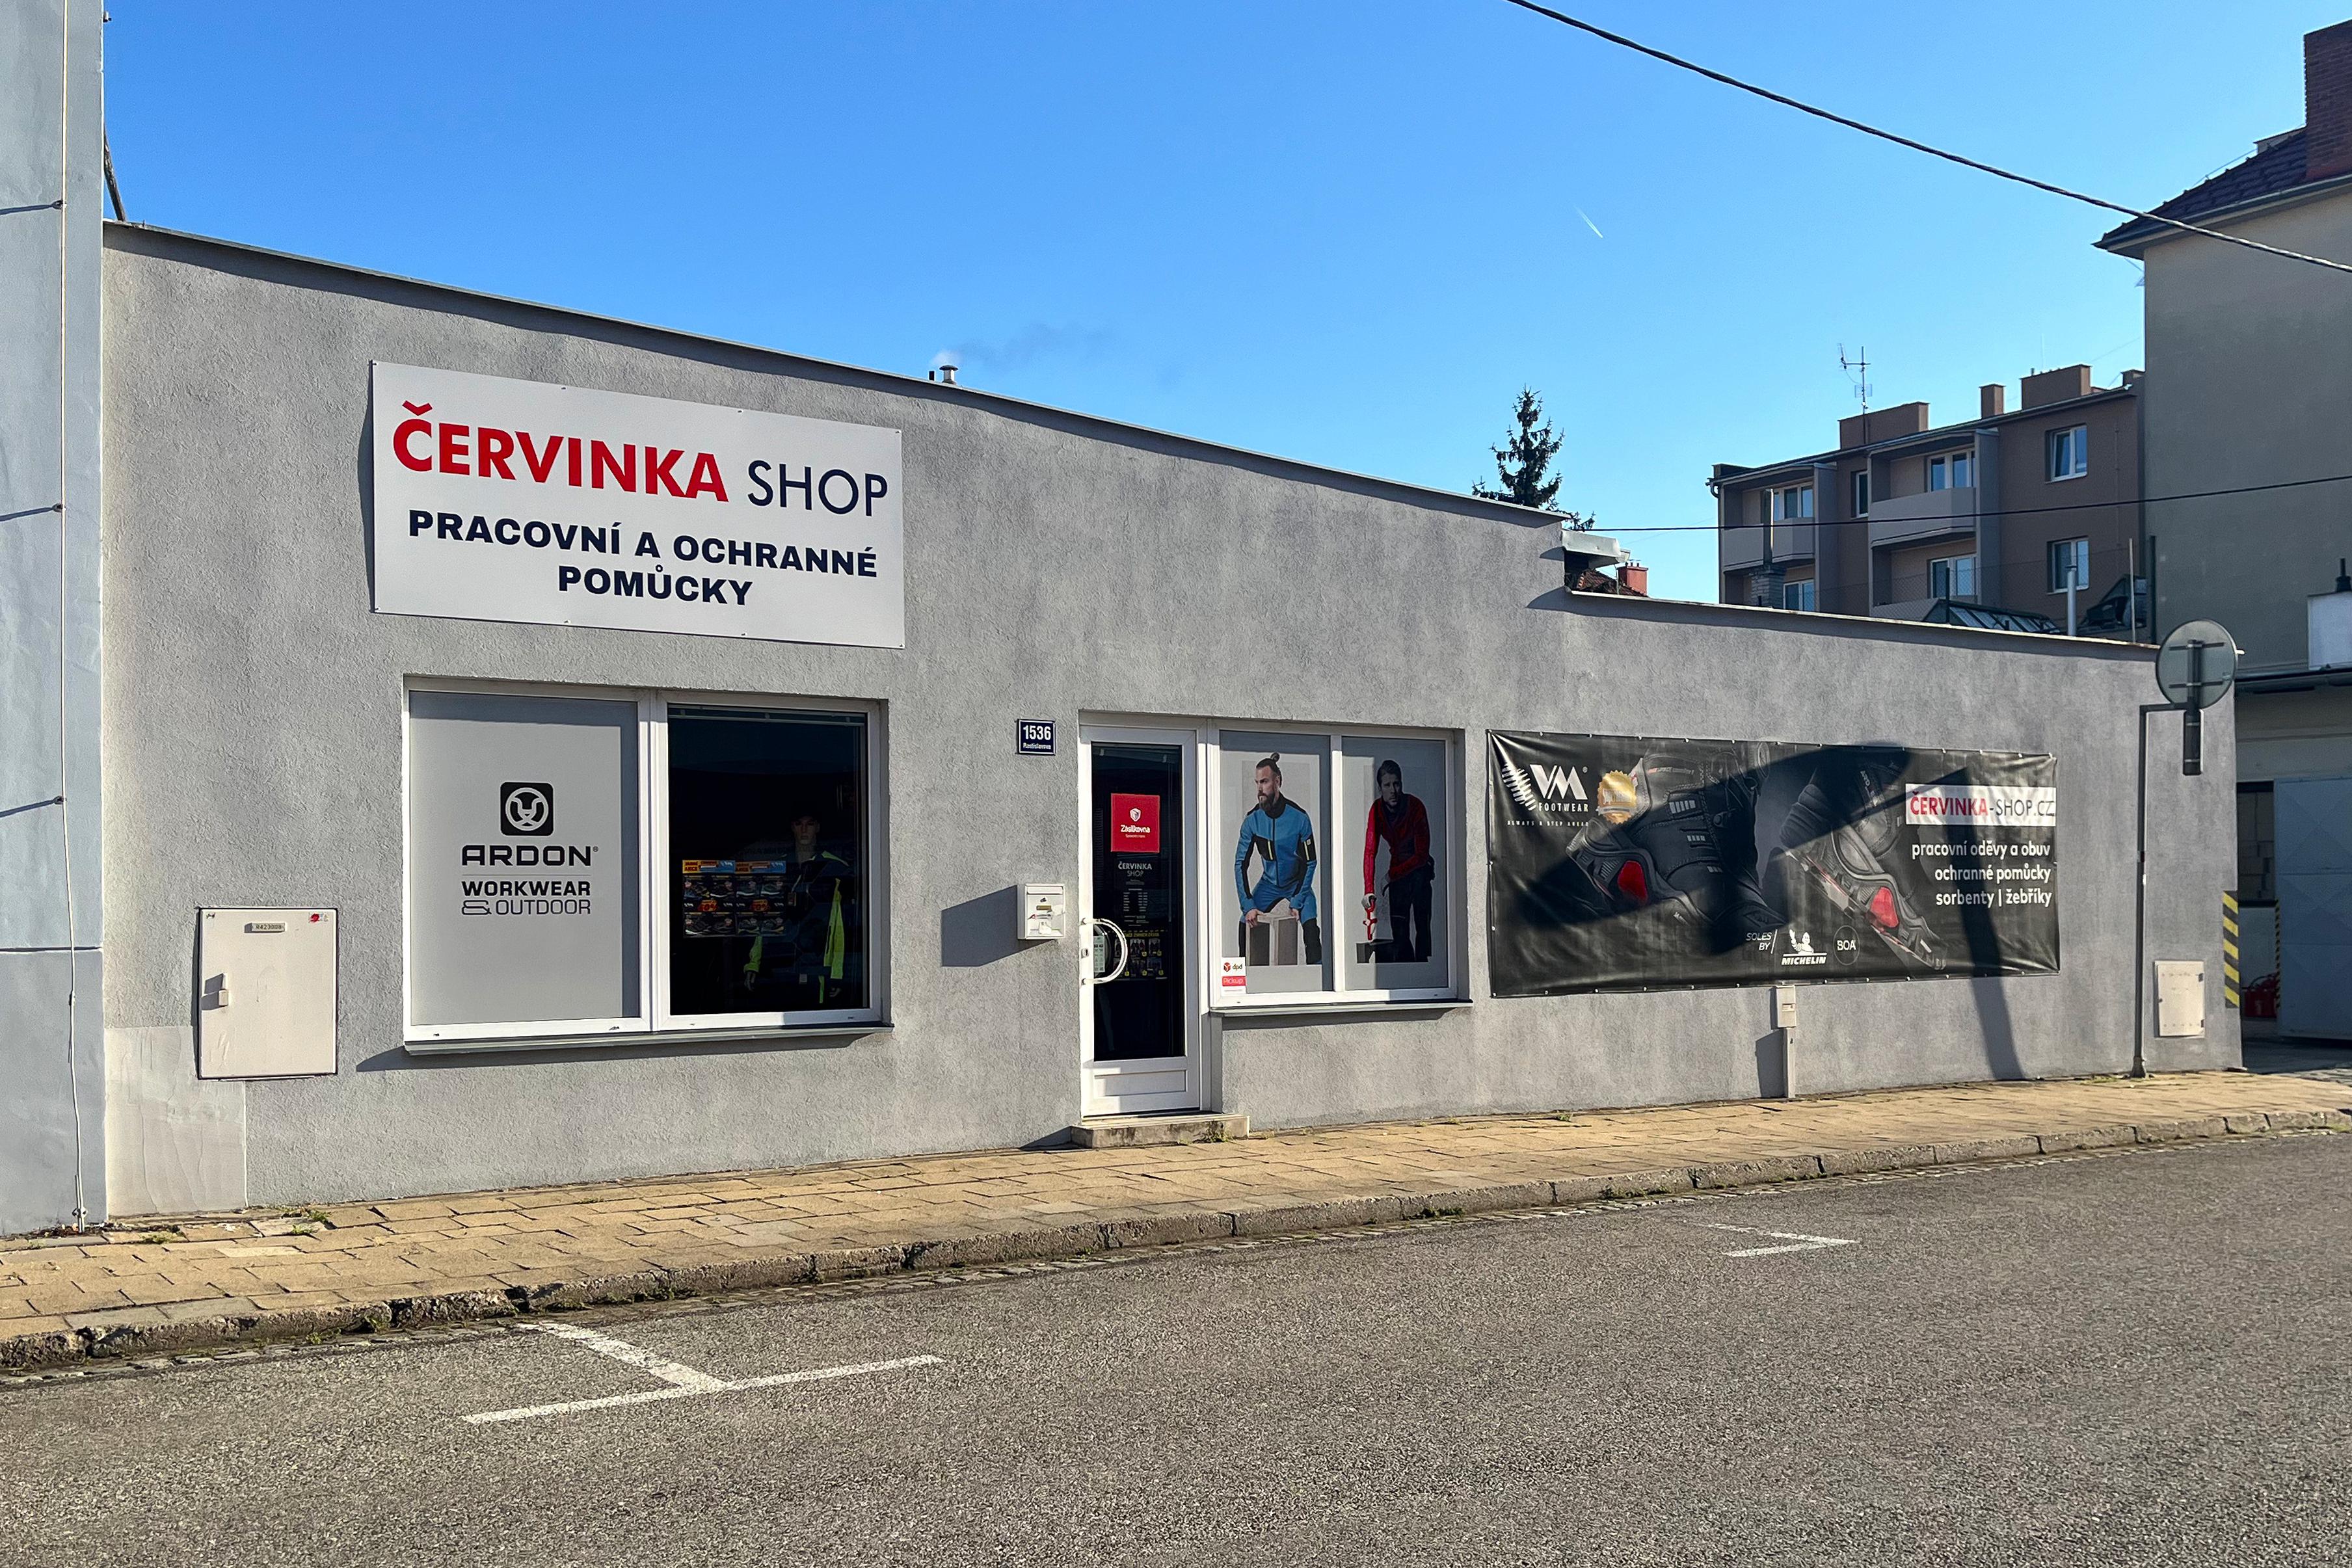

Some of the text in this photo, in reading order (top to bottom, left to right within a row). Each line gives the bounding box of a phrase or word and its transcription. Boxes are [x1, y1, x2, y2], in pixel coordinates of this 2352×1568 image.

[393, 400, 889, 517] ČERVINKA SHOP
[409, 509, 877, 578] PRACOVNÍ A OCHRANNÉ
[558, 564, 753, 606] POMŮCKY
[1022, 724, 1051, 741] 1536
[1530, 764, 1588, 801] VM
[1538, 802, 1589, 812] FOOTWEAR
[1910, 790, 2055, 817] ČERVINKA-SHOP.CZ
[1912, 840, 2050, 860] pracovní oděvy a obuv
[1118, 860, 1153, 870] ČERVINKA
[1934, 862, 2051, 884] ochranné pomůcky
[461, 881, 591, 896] WORKWEAR
[496, 899, 591, 915] OUTDOOR
[1936, 889, 1995, 909] sorbenty
[2005, 888, 2052, 908] žebříky
[1746, 931, 1772, 941] SOLES
[1758, 942, 1771, 951] BY
[1837, 940, 1856, 951] BOA
[1781, 956, 1826, 966] MICHELIN
